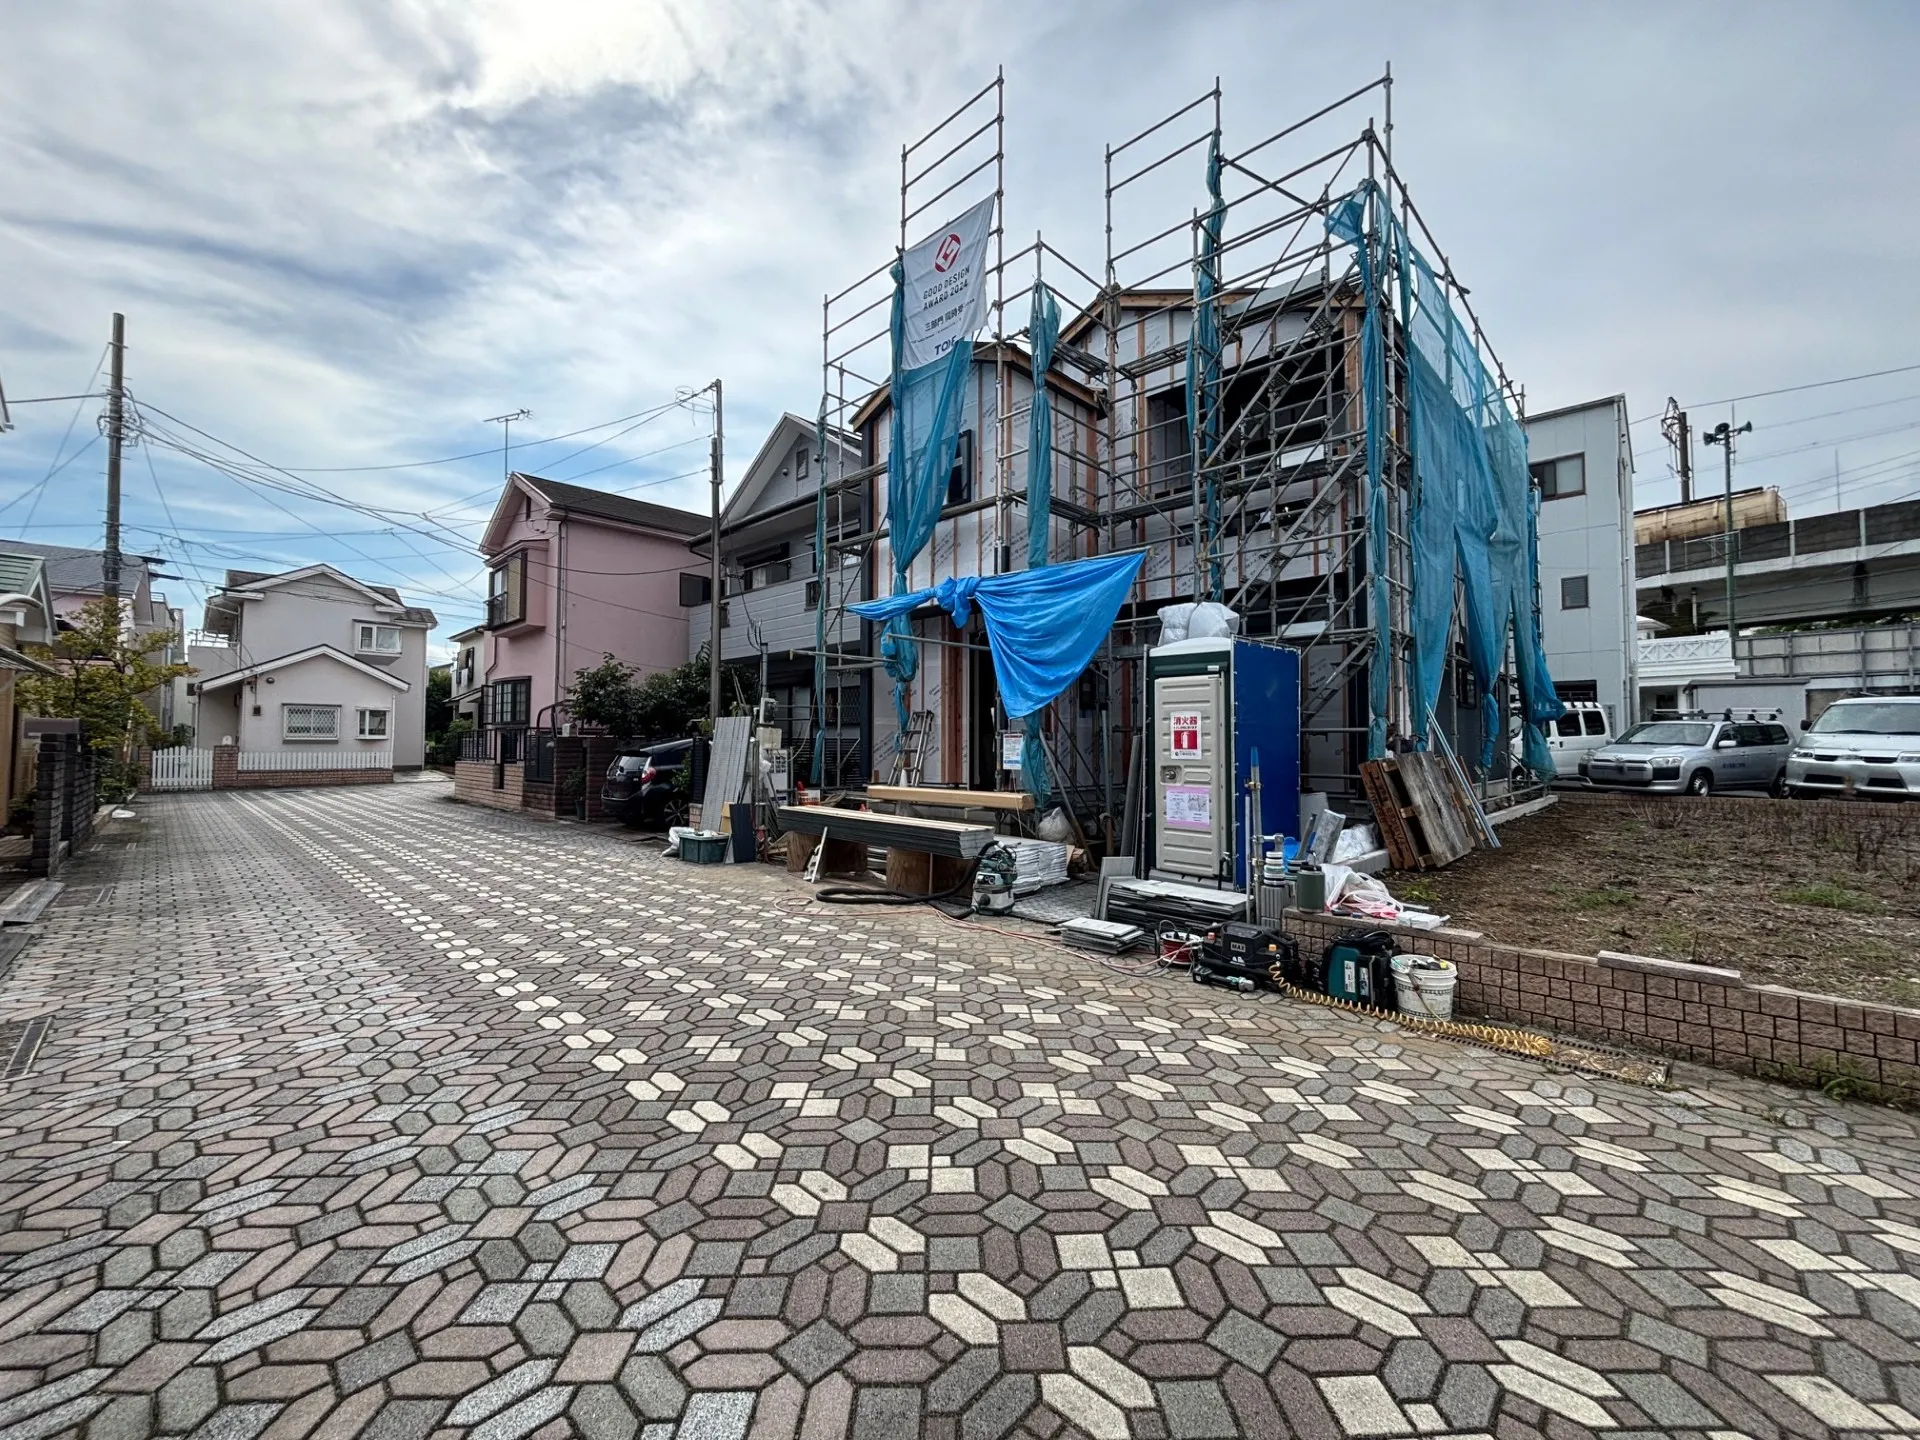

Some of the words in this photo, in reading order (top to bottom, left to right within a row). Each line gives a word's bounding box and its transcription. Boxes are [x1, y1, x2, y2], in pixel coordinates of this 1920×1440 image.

[923, 283, 943, 300] GOOD
[944, 265, 970, 289] DESIGN
[923, 291, 949, 311] AWARD
[950, 279, 968, 297] 2024
[1173, 716, 1198, 726] 消火器
